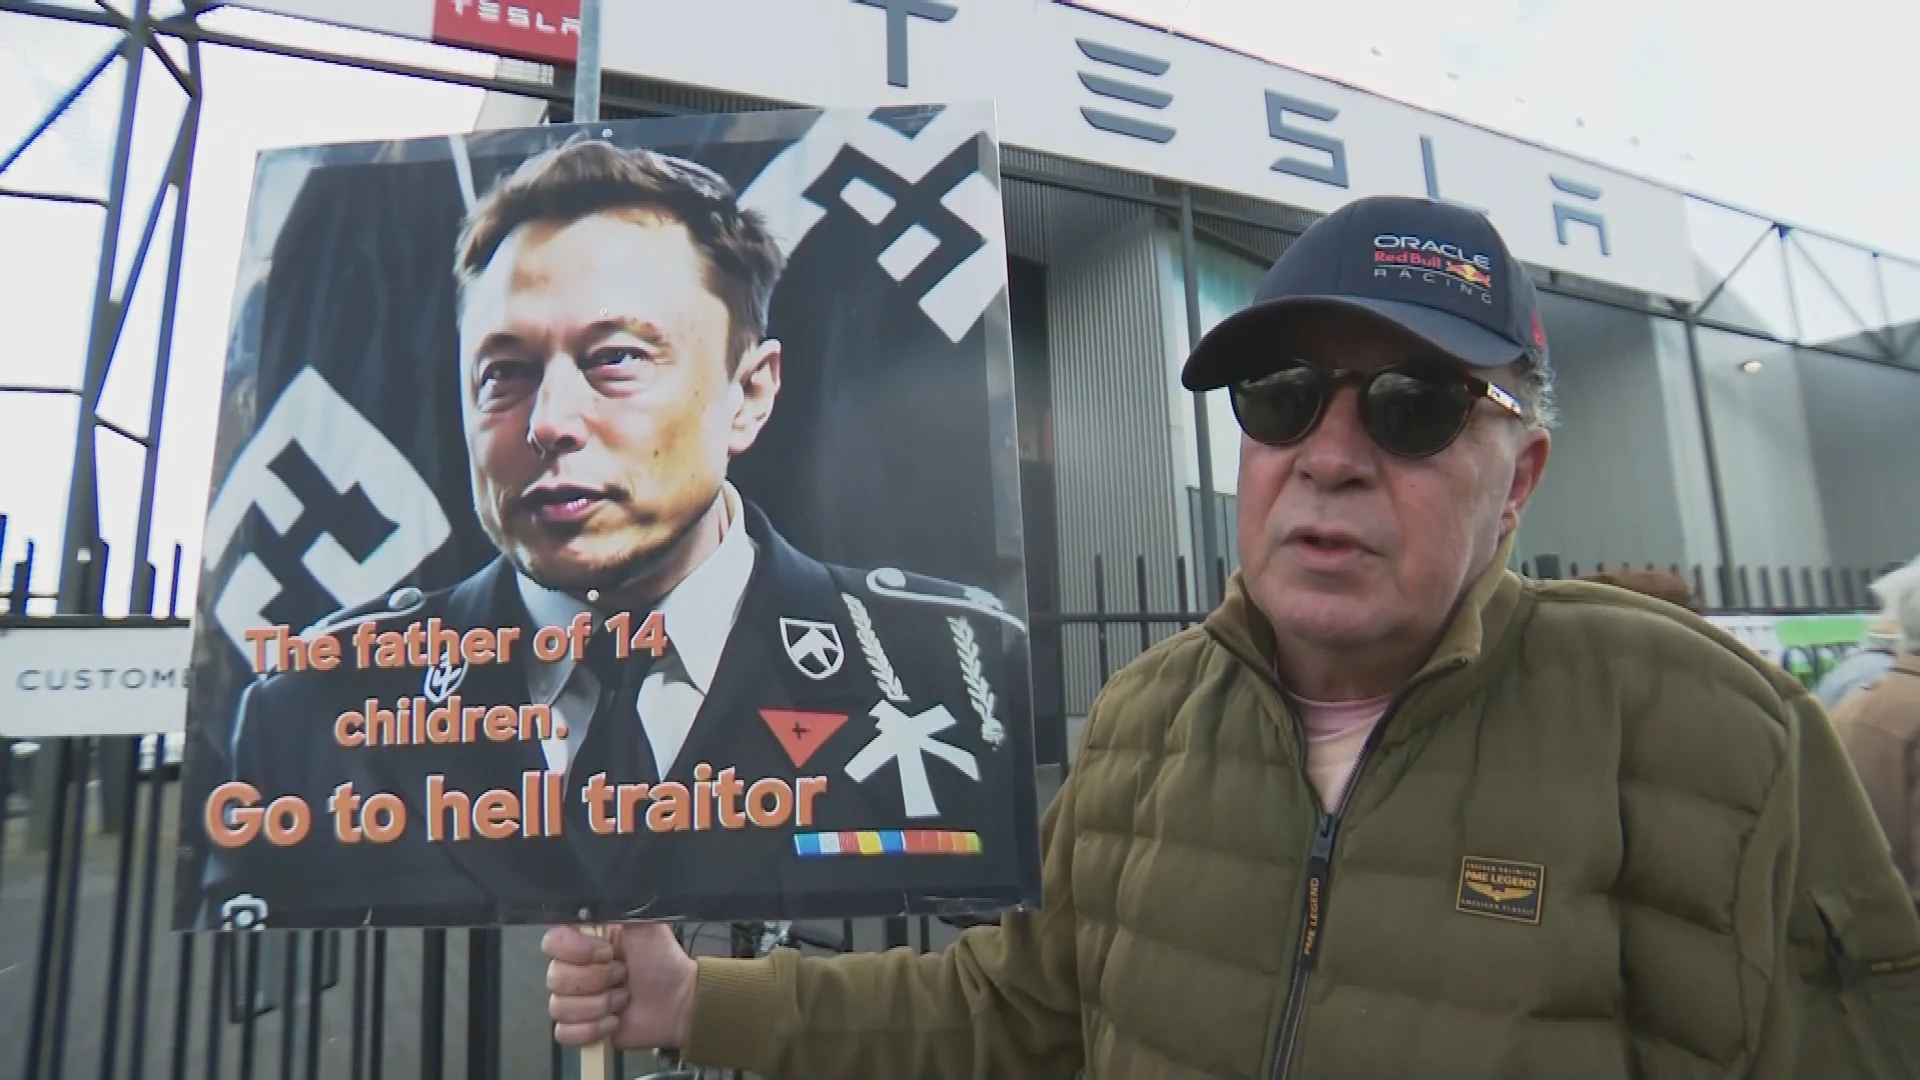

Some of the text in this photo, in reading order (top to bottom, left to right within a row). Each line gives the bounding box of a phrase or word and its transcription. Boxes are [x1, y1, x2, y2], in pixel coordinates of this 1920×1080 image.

[453, 0, 580, 36] TESLA
[848, 0, 1610, 257] TESLA
[1374, 234, 1492, 271] ORACLE
[1374, 250, 1442, 269] Red Bull
[1374, 267, 1492, 304] RACING
[244, 611, 668, 674] The father of 14
[334, 696, 569, 747] children.
[205, 763, 828, 848] Go to hell traitor
[1465, 870, 1488, 882] PME
[1491, 873, 1536, 889] LEGEND
